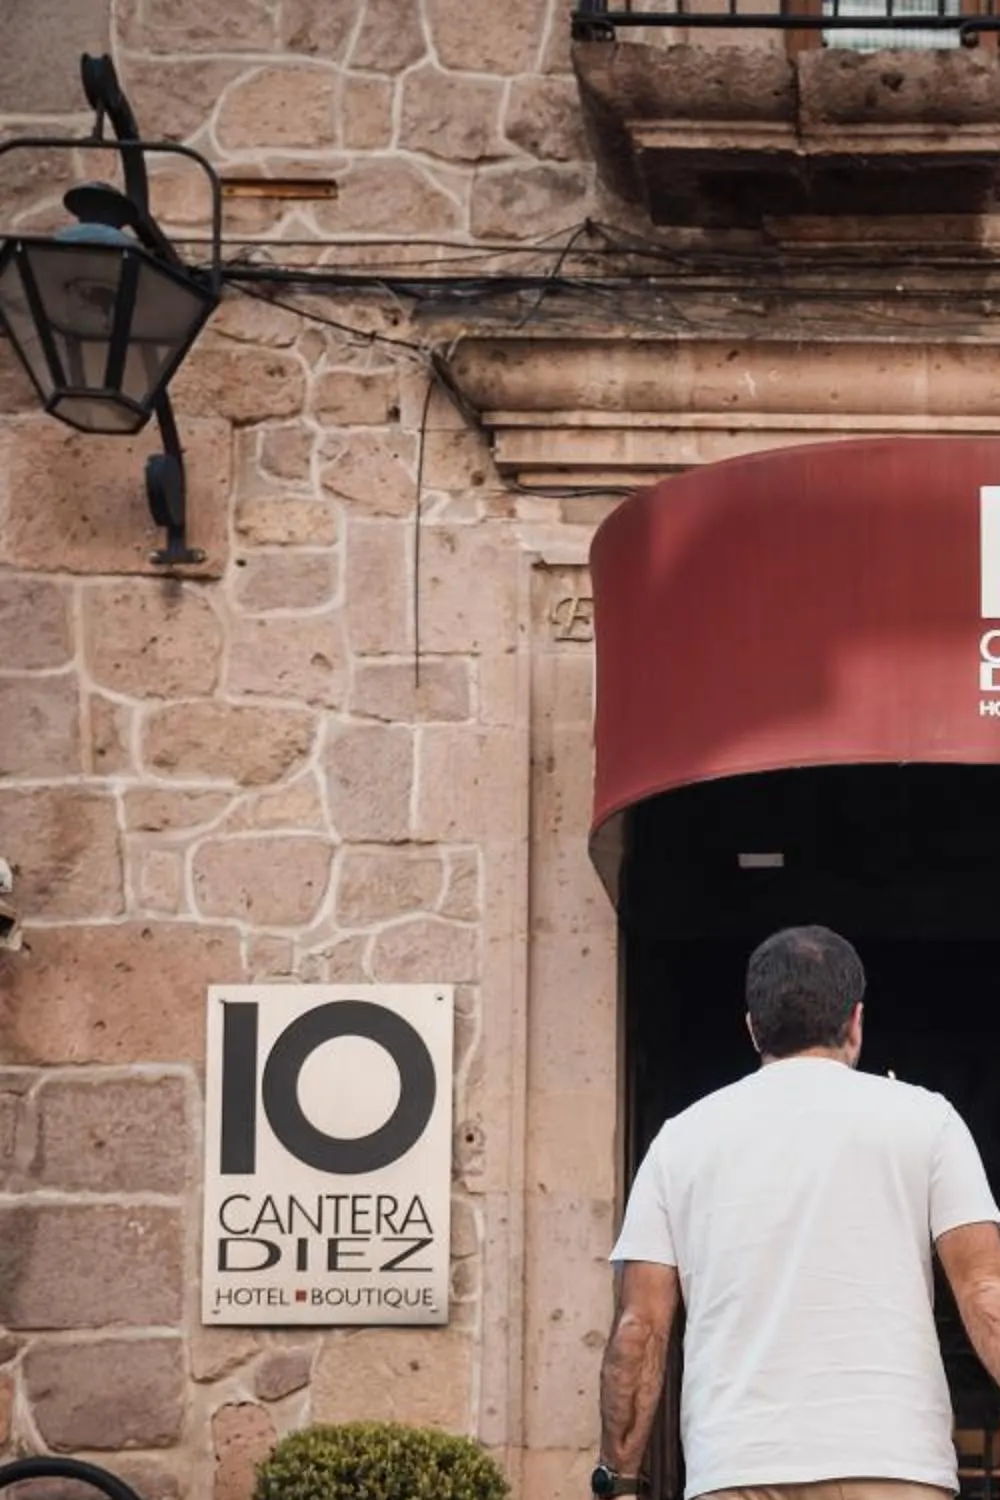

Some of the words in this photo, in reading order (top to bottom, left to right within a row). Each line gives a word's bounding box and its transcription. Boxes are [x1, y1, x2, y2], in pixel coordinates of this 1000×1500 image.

[218, 1194, 434, 1235] CANTERA
[217, 1237, 435, 1273] DIEZ
[215, 1287, 290, 1306] HOTEL
[311, 1287, 433, 1308] BOUTIQUE
